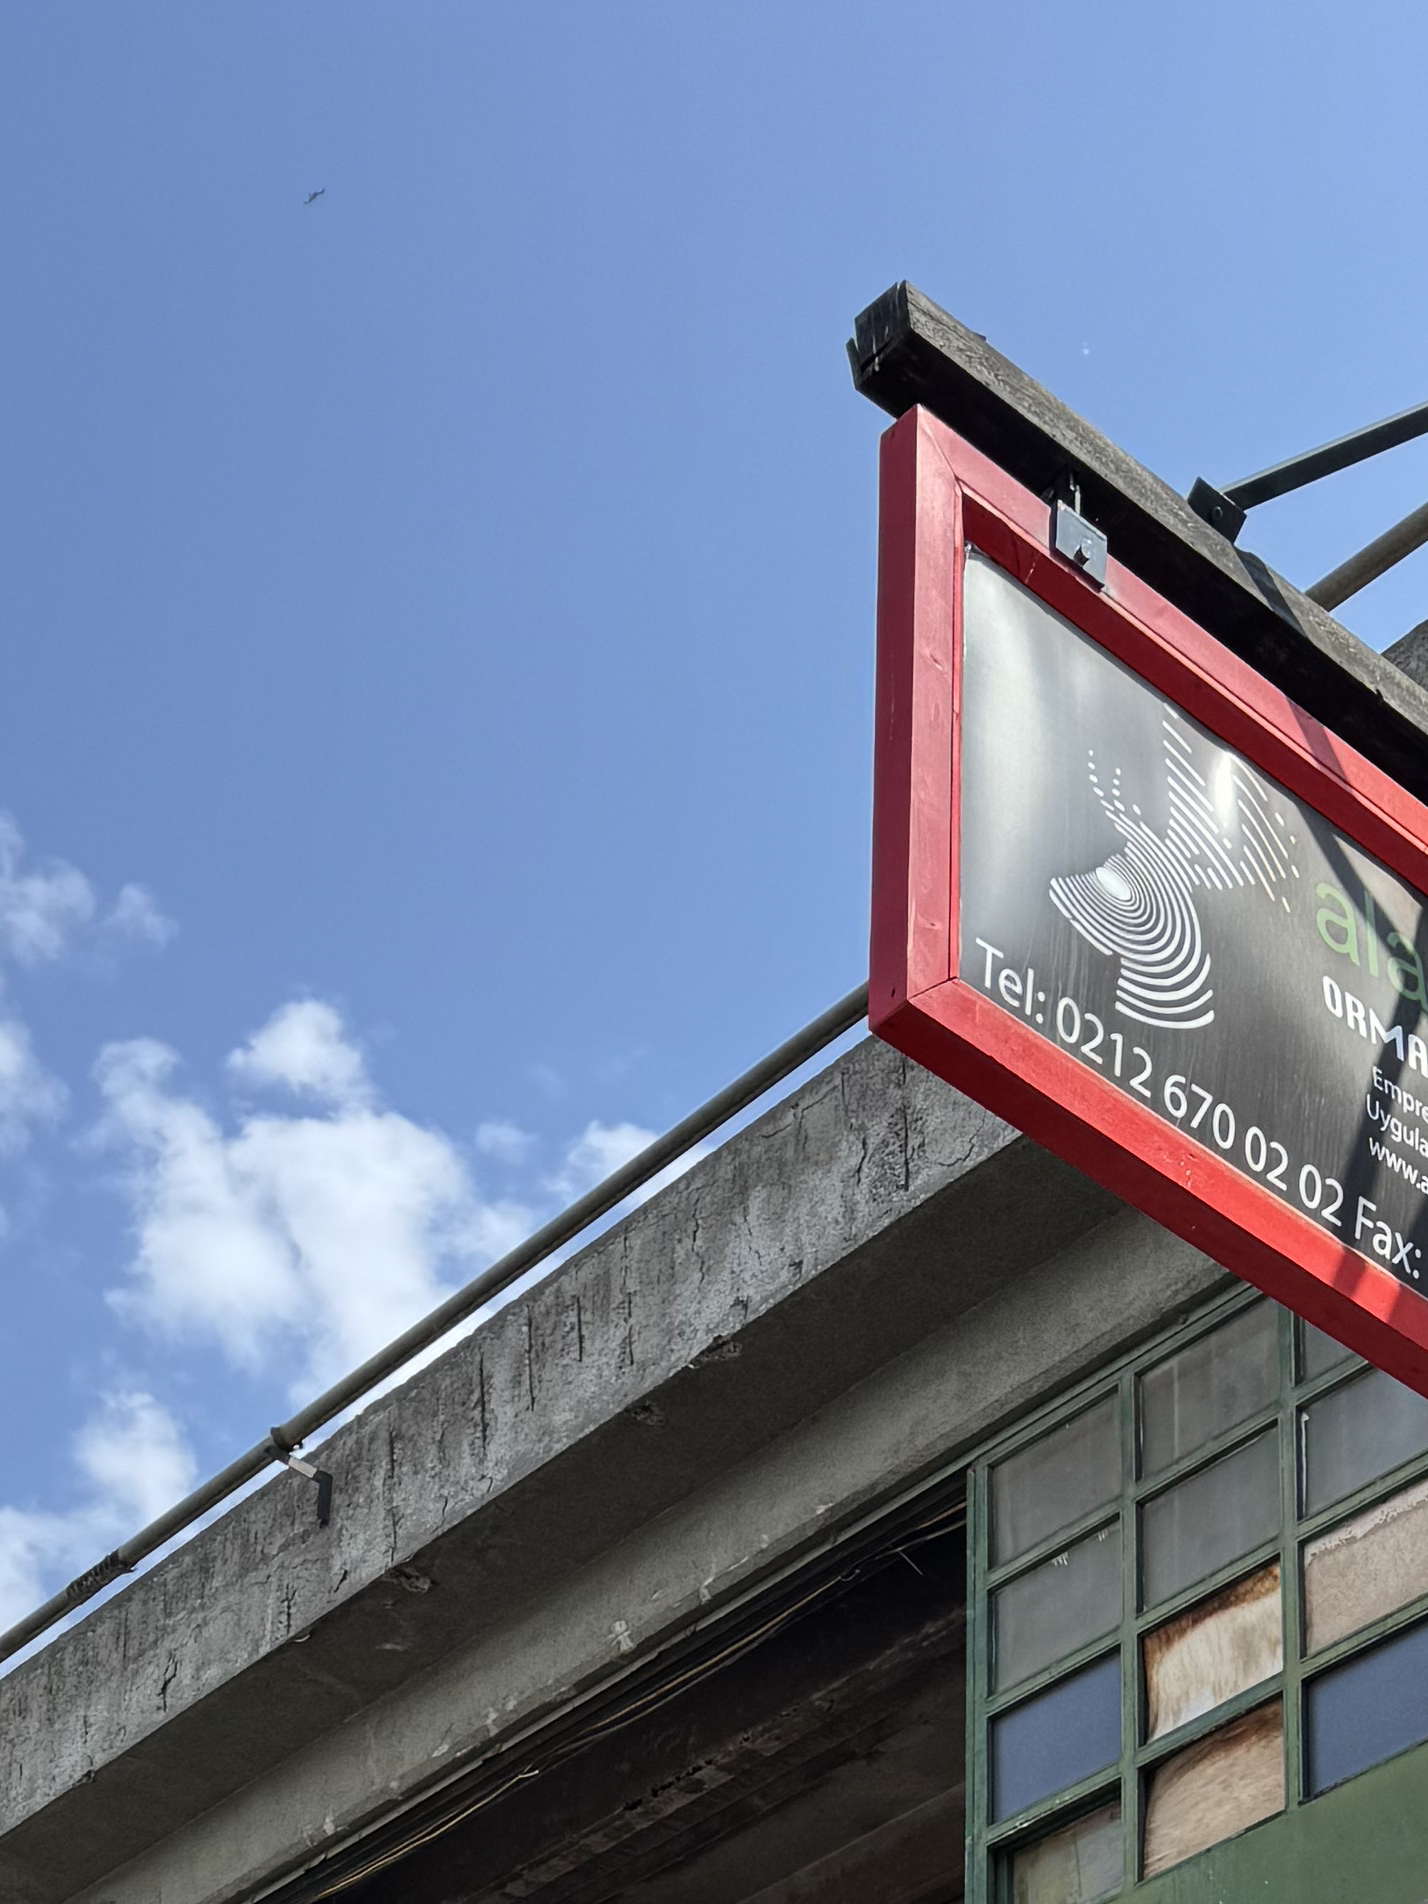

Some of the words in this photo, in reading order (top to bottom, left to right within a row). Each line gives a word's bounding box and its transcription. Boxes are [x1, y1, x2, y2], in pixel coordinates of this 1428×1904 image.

[975, 937, 1046, 1024] Tel:
[1056, 997, 1153, 1098] 0212
[1163, 1074, 1236, 1150] 670
[1244, 1125, 1289, 1191] 02
[1298, 1164, 1344, 1227] 02
[1354, 1196, 1422, 1279] Fax:
